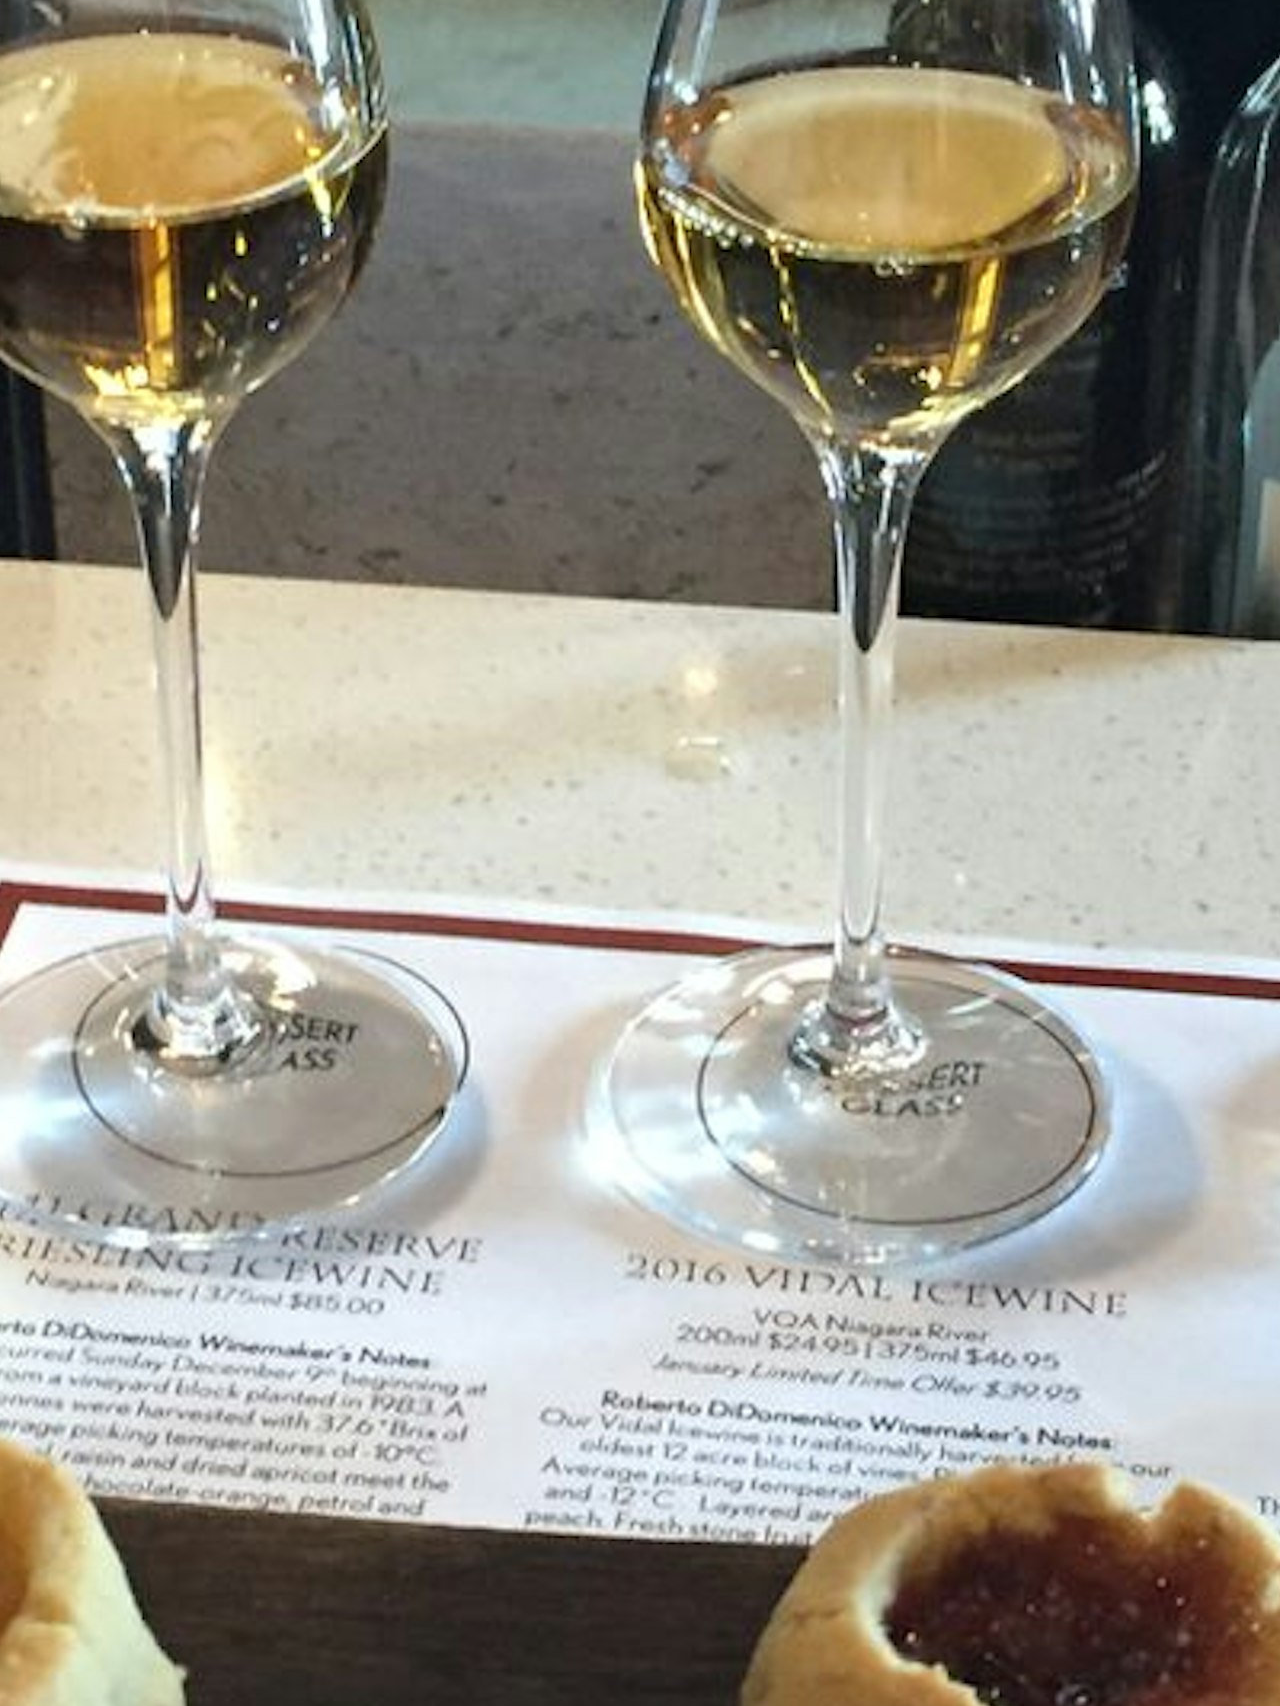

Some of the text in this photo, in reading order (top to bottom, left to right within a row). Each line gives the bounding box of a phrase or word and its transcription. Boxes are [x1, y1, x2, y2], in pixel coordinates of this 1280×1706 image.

[281, 1225, 485, 1264] RESERVE
[25, 1270, 118, 1294] Niagara
[124, 1279, 184, 1299] River
[230, 1253, 448, 1296] ICEWINE
[624, 1252, 1128, 1318] 2016 VIDAL ICEWINE
[41, 1319, 192, 1350] DiDomenico
[199, 1332, 352, 1363] Winemaker's
[358, 1345, 431, 1370] Notes
[825, 1312, 990, 1342] Niagara River
[80, 1346, 167, 1374] Sunday
[172, 1354, 298, 1382] December
[341, 1368, 461, 1399] beginning
[466, 1381, 488, 1398] at
[651, 1352, 742, 1380] January
[749, 1361, 843, 1386] Limited
[847, 1368, 905, 1390] Time
[910, 1373, 976, 1397] Offer
[68, 1373, 170, 1398] vineyard
[174, 1377, 239, 1402] block
[244, 1385, 337, 1413] planted
[340, 1393, 363, 1410] in
[444, 1400, 466, 1418] A
[70, 1422, 161, 1447] picking
[165, 1429, 326, 1458] temperatures
[332, 1441, 360, 1460] of
[72, 1399, 131, 1415] were
[136, 1400, 256, 1425] harvested
[261, 1411, 311, 1432] with
[442, 1424, 469, 1443] of
[538, 1406, 590, 1430] Our
[601, 1412, 664, 1434] Vidal
[667, 1421, 761, 1443] Icewine
[767, 1430, 786, 1446] is
[791, 1432, 932, 1463] traditionally
[601, 1389, 1113, 1451] Roberto DiDomenico Winemaker's Notes
[131, 1451, 178, 1471] and
[182, 1455, 248, 1479] dried
[251, 1464, 337, 1490] apricot
[344, 1471, 405, 1491] meet
[410, 1475, 450, 1494] the
[540, 1456, 745, 1494] Average picking
[579, 1436, 656, 1458] oldest
[662, 1442, 687, 1461] 12
[693, 1451, 748, 1467] acre
[754, 1450, 821, 1473] block
[827, 1459, 853, 1476] of
[298, 1492, 428, 1517] petrol and
[544, 1483, 592, 1502] and
[699, 1494, 802, 1523] Layered
[614, 1509, 685, 1533] Fresh
[689, 1520, 758, 1540] stone
